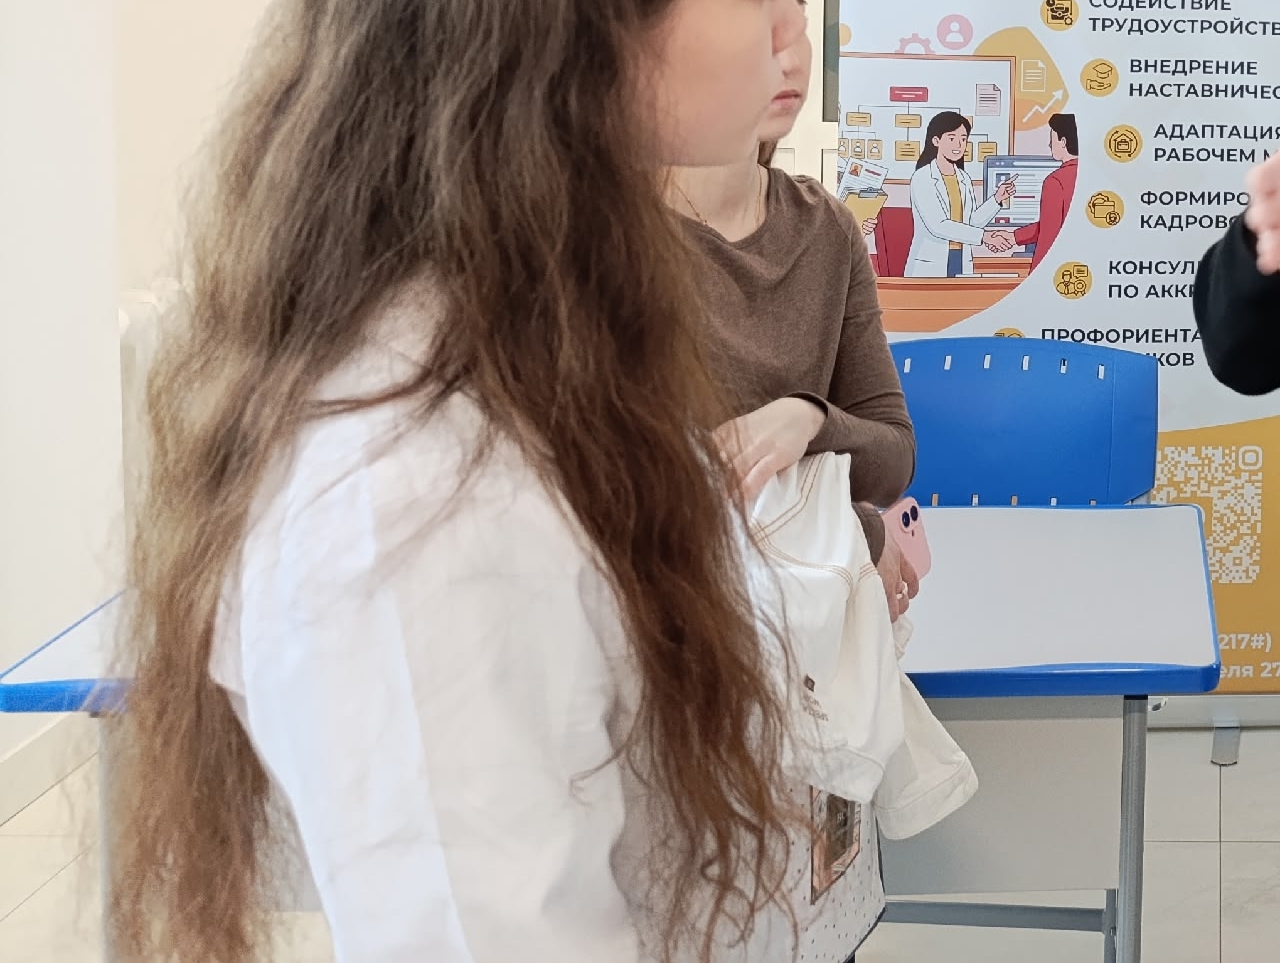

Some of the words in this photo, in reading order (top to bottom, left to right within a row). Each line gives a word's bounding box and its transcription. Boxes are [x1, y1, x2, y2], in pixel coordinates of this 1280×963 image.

[1129, 58, 1258, 77] ВНЕДРЕНИЕ
[1154, 147, 1256, 163] РАБОЧЕМ
[1140, 190, 1250, 206] ФОРМИРО
[1108, 260, 1200, 276] КОНСУЛ
[1108, 283, 1139, 299] ПО
[1041, 328, 1201, 344] ПРОФОРИЕНТА
[1217, 632, 1272, 653] 217#)
[1219, 665, 1254, 678] еля
